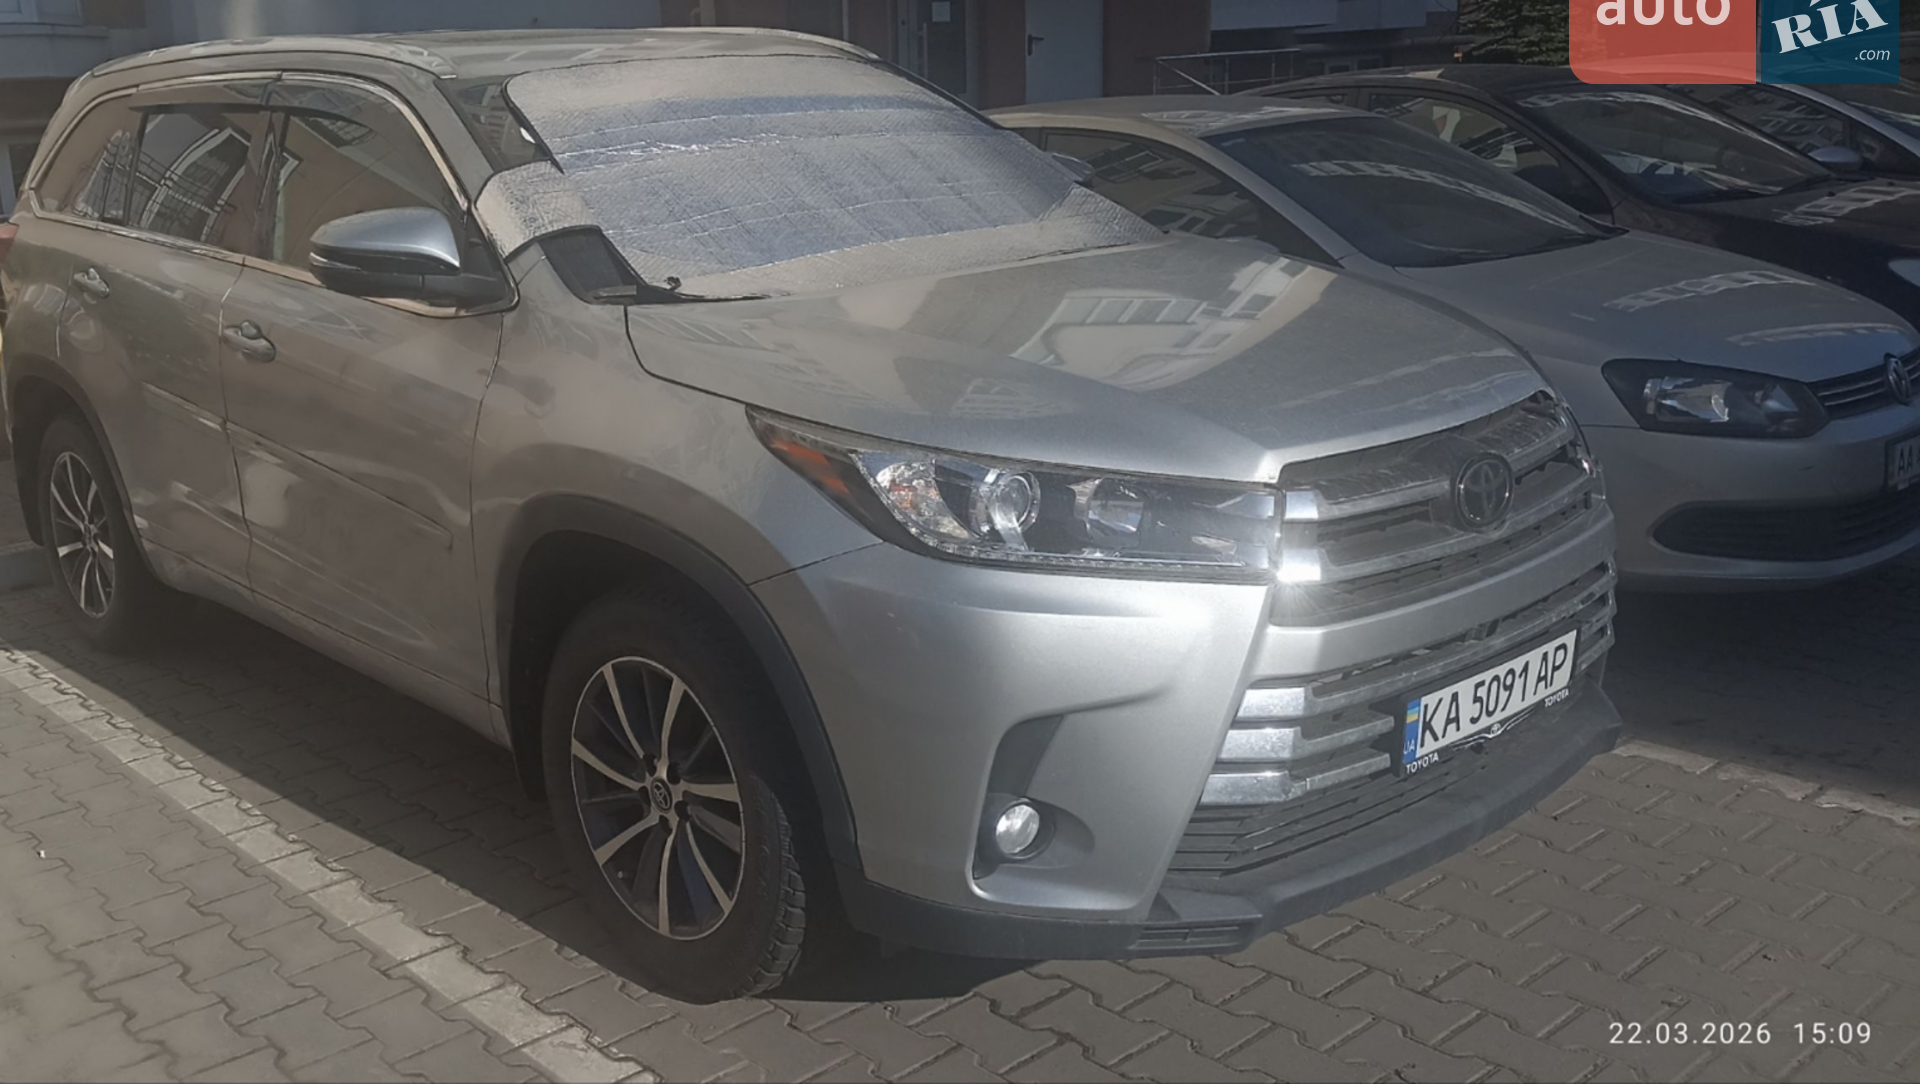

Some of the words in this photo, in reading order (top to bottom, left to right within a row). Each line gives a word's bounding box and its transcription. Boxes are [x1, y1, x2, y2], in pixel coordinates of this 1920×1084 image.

[1420, 691, 1461, 749] KA
[1469, 660, 1530, 725] 5091
[1534, 643, 1567, 695] AP
[1545, 689, 1569, 708] TOYOTA
[1403, 739, 1416, 755] UA
[1407, 752, 1439, 774] TOYOTA
